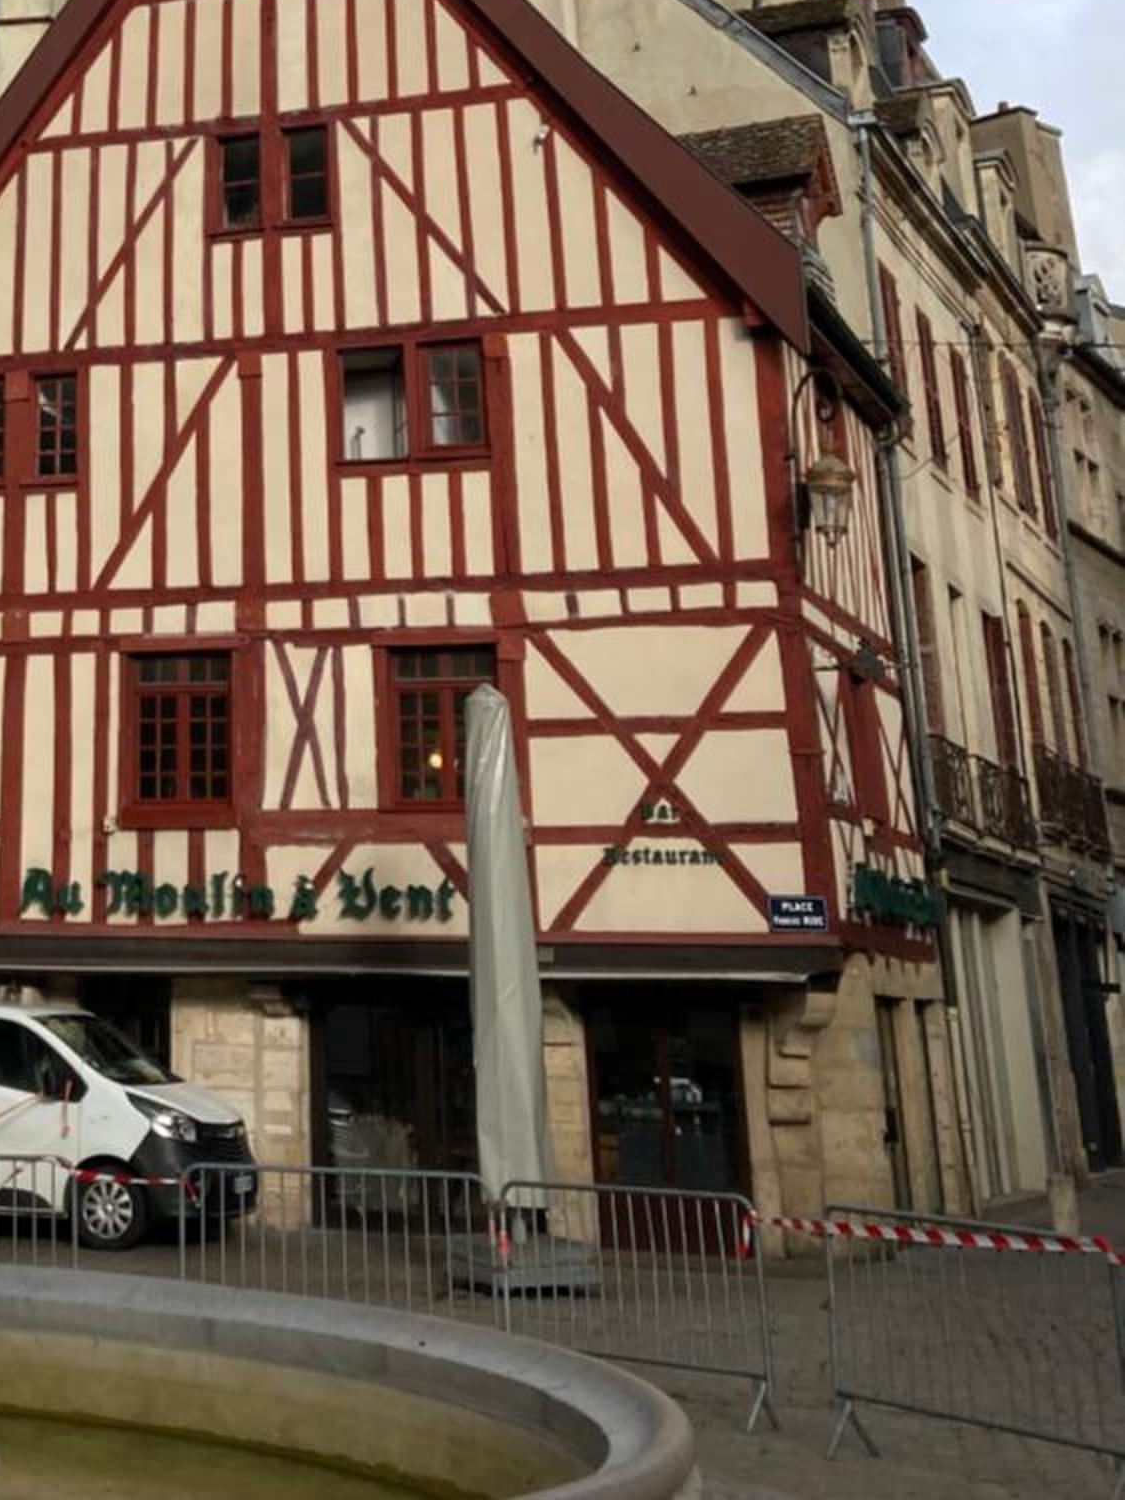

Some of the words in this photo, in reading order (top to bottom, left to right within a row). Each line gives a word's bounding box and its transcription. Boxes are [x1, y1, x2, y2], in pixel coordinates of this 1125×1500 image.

[19, 867, 84, 918] Au
[94, 869, 274, 920] Moulin
[288, 873, 317, 922] à
[337, 866, 455, 924] Vent
[781, 901, 814, 913] PLACE
